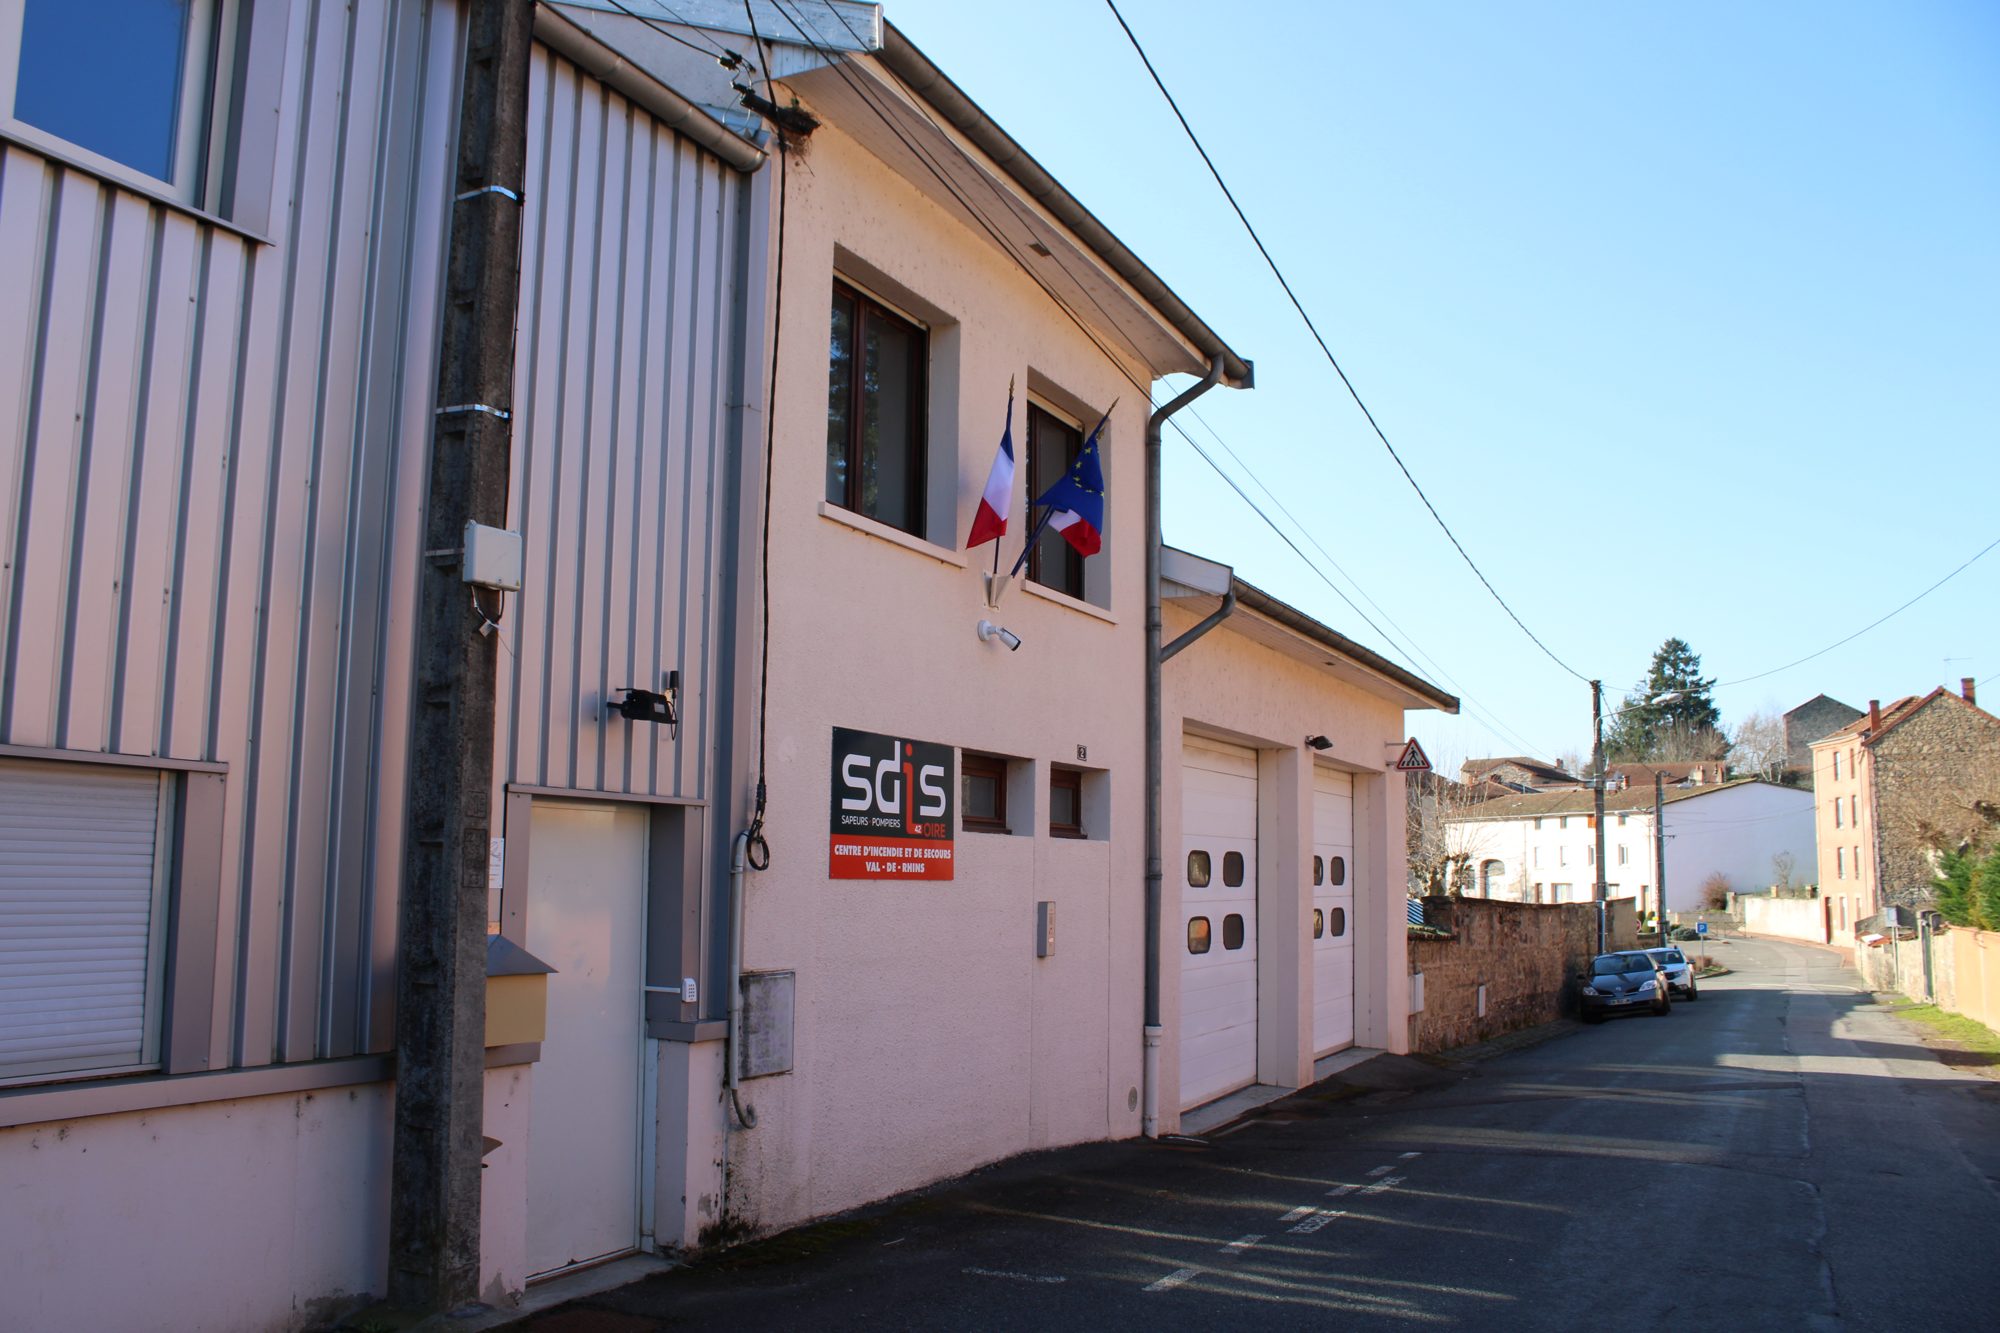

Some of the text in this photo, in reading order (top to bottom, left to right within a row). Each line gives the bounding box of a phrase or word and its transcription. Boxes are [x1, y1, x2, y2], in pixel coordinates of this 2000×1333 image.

[841, 815, 901, 828] SAPEURS POMPIERS
[834, 844, 951, 859] CENTRE D'INCENDIE ET DE SECOURS
[865, 862, 880, 872] VAL
[886, 862, 897, 872] DE
[902, 863, 925, 873] RHINS
